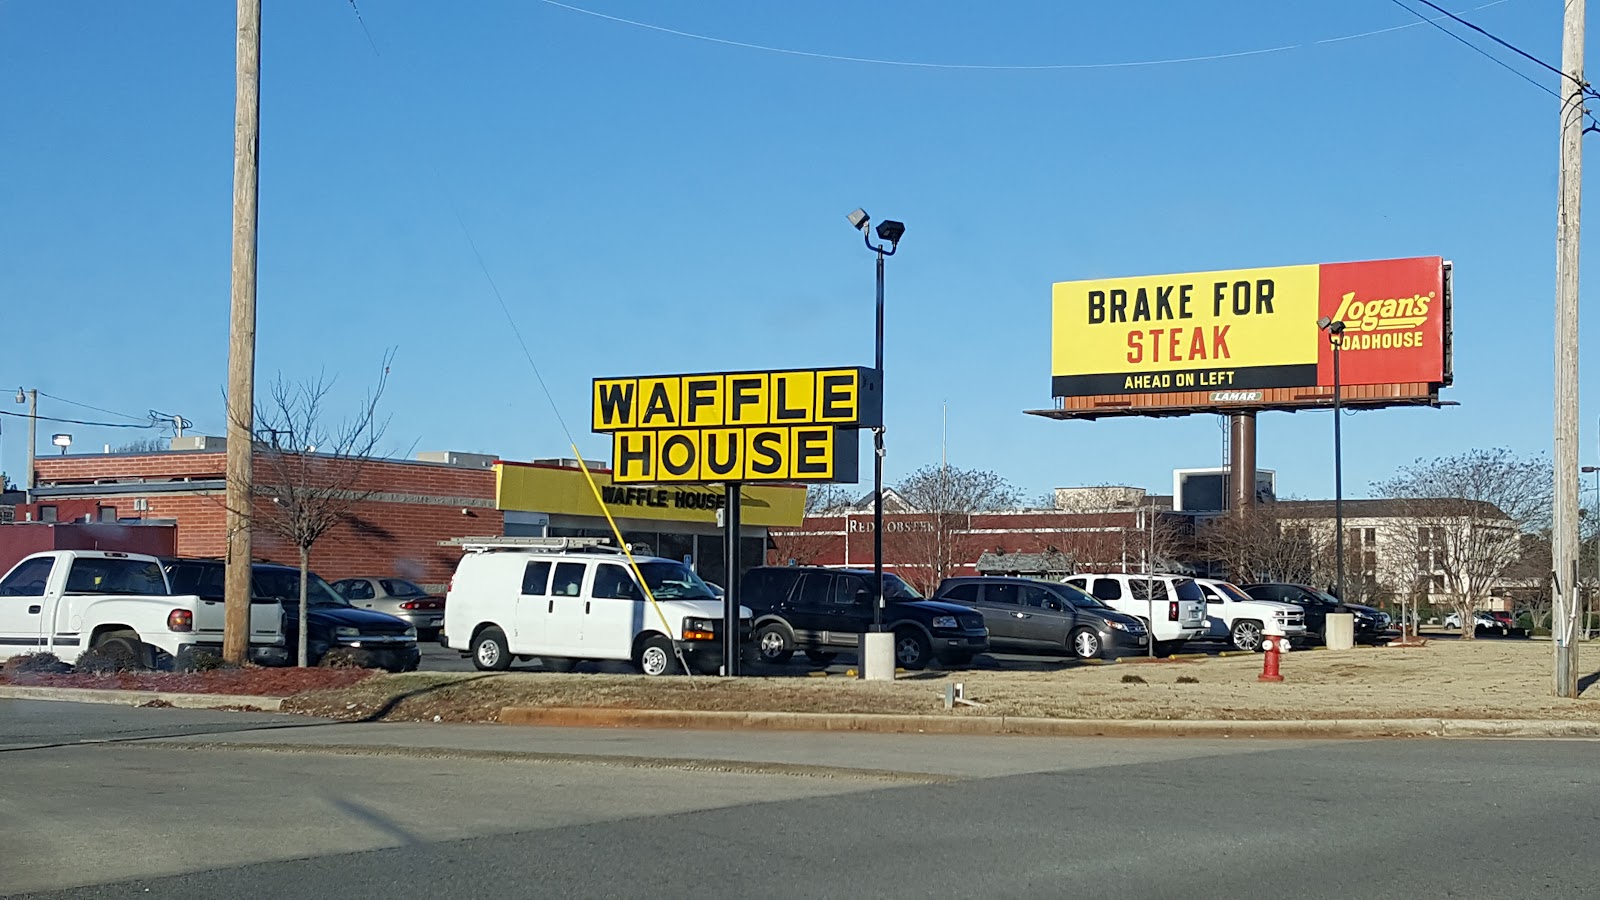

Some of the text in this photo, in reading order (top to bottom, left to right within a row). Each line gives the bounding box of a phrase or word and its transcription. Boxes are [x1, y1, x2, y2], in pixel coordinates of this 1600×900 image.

[1088, 279, 1275, 325] BRAKE FOR
[1126, 325, 1232, 364] STEAK
[599, 375, 855, 424] WAFFLE
[1124, 371, 1236, 389] AHEAD ON LEFT
[1214, 391, 1257, 401] LAMAR
[620, 430, 828, 477] HOUSE
[602, 486, 726, 510] WAFFLE HOUSE
